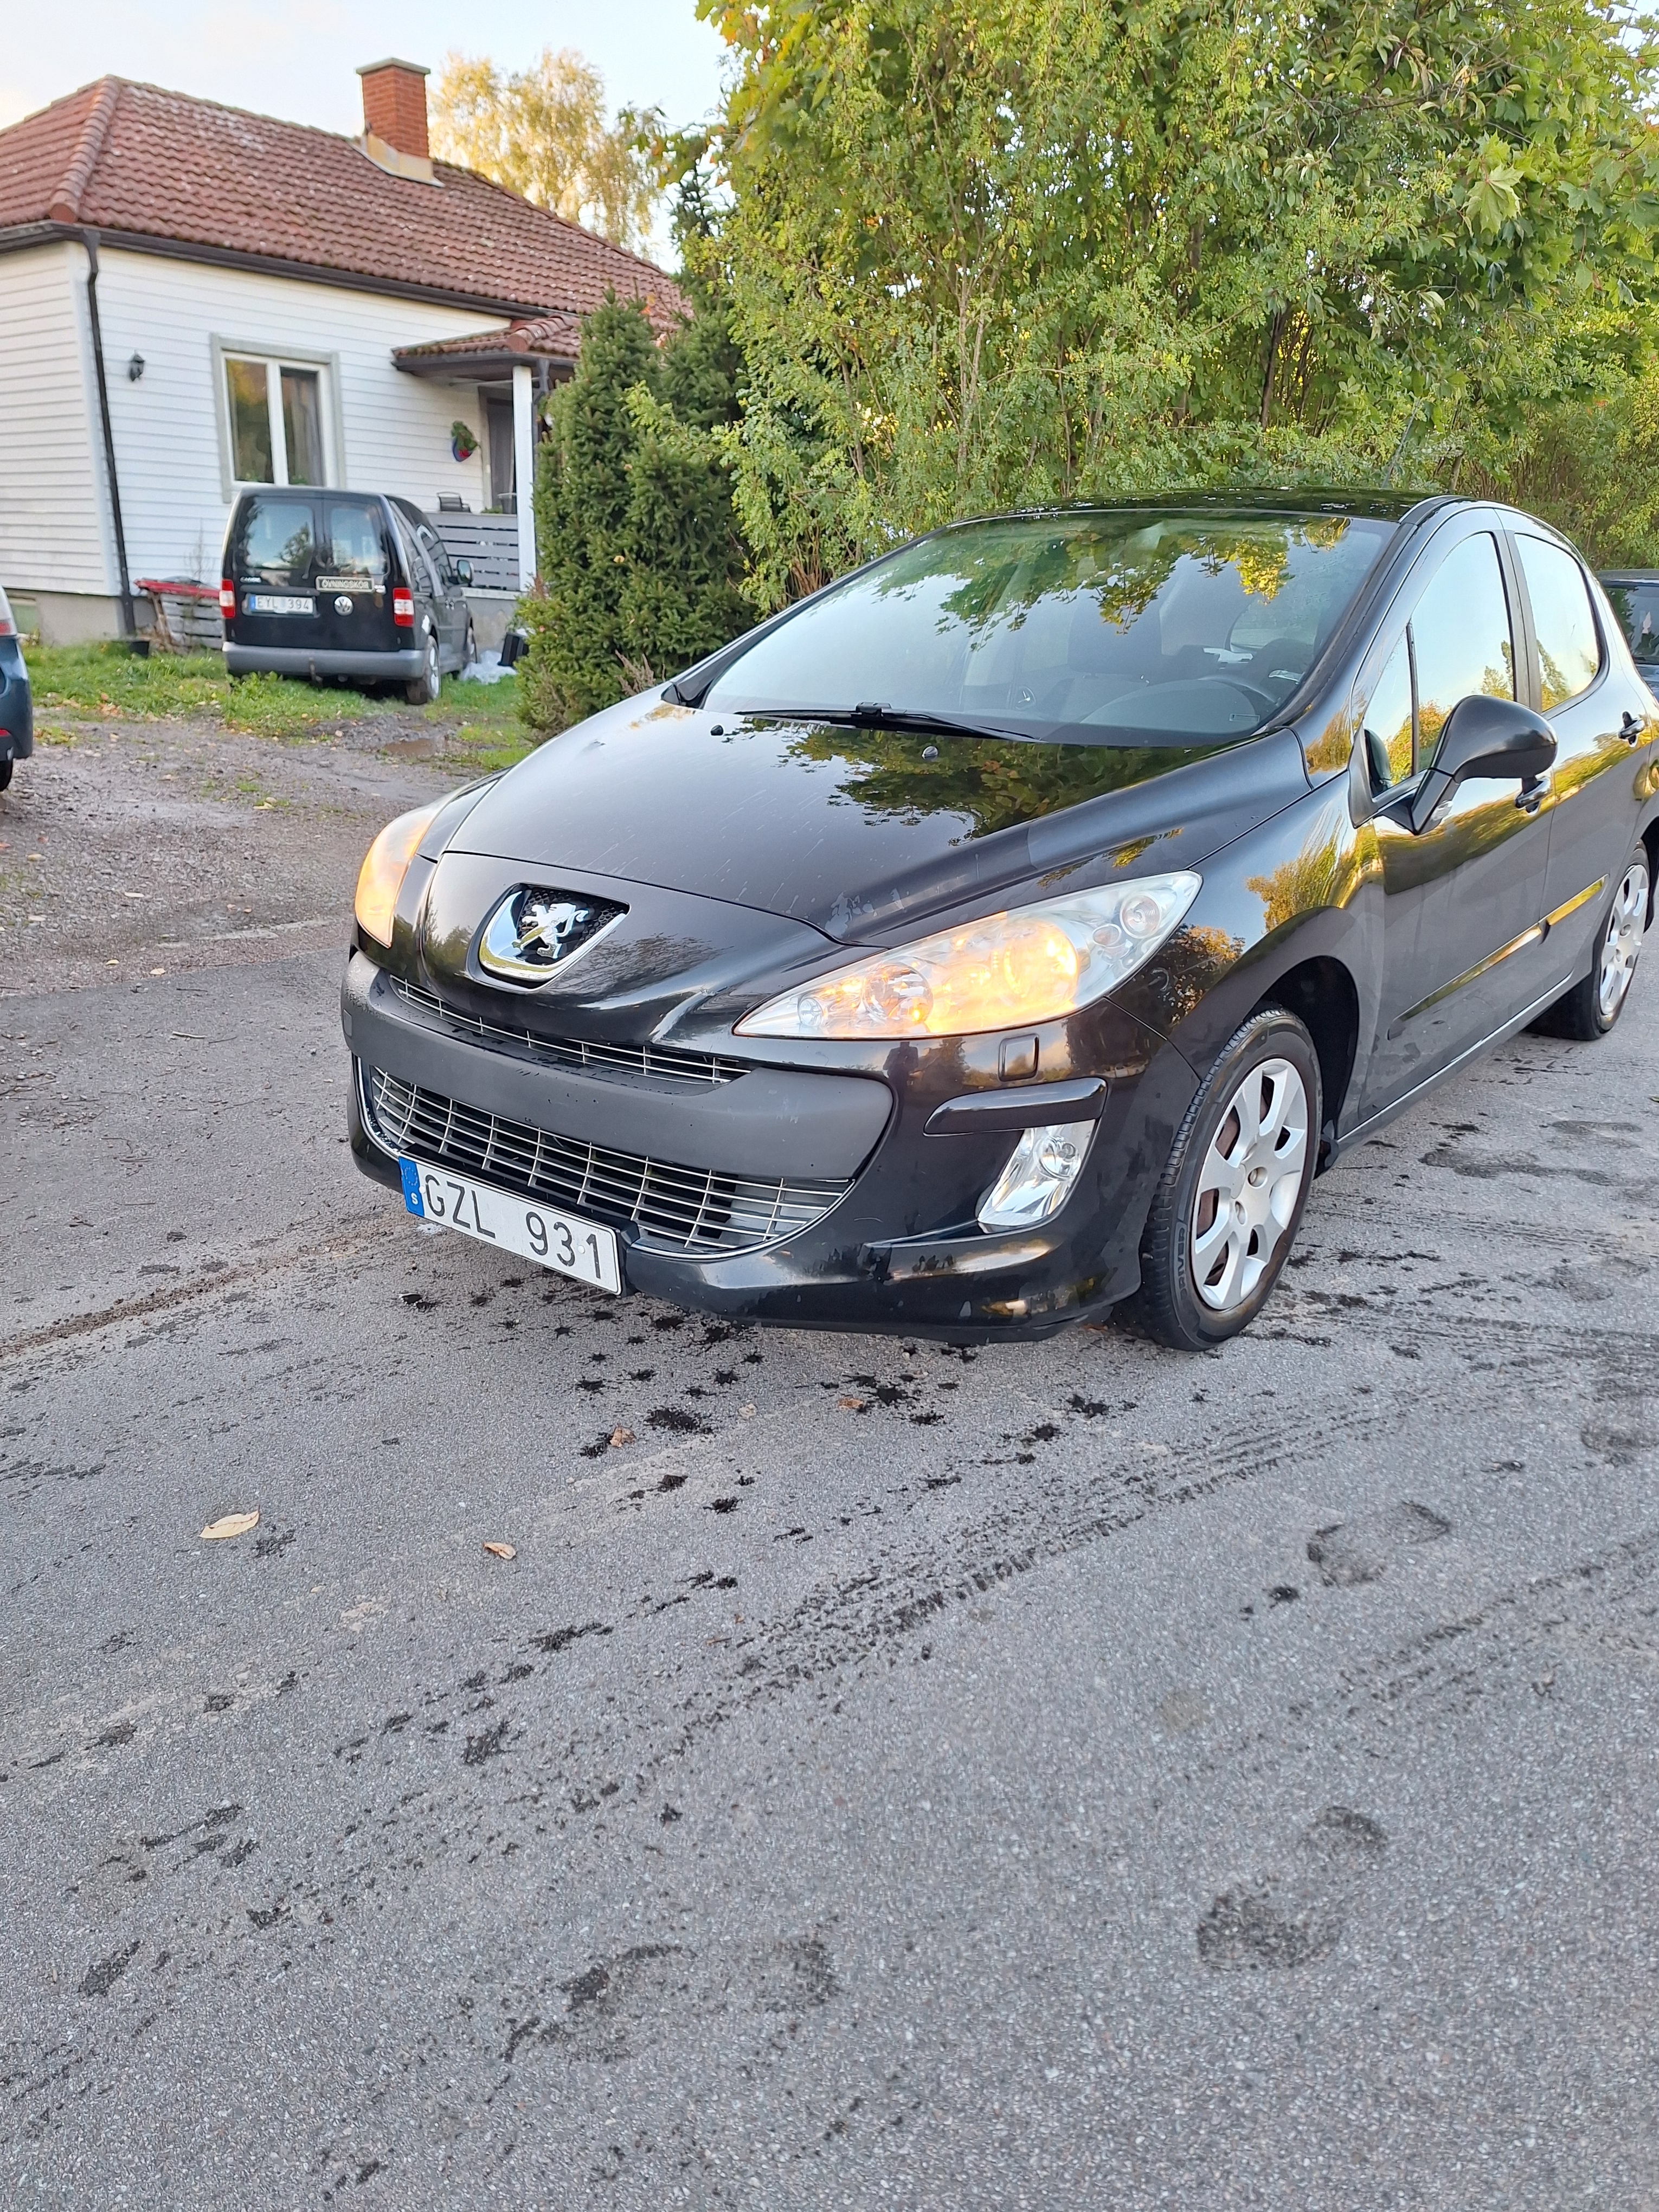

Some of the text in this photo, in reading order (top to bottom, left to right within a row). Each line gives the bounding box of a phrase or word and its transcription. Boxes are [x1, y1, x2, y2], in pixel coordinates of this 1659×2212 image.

[258, 597, 309, 610] EYL 394
[411, 1193, 419, 1205] S
[425, 1174, 601, 1279] GZL 931
